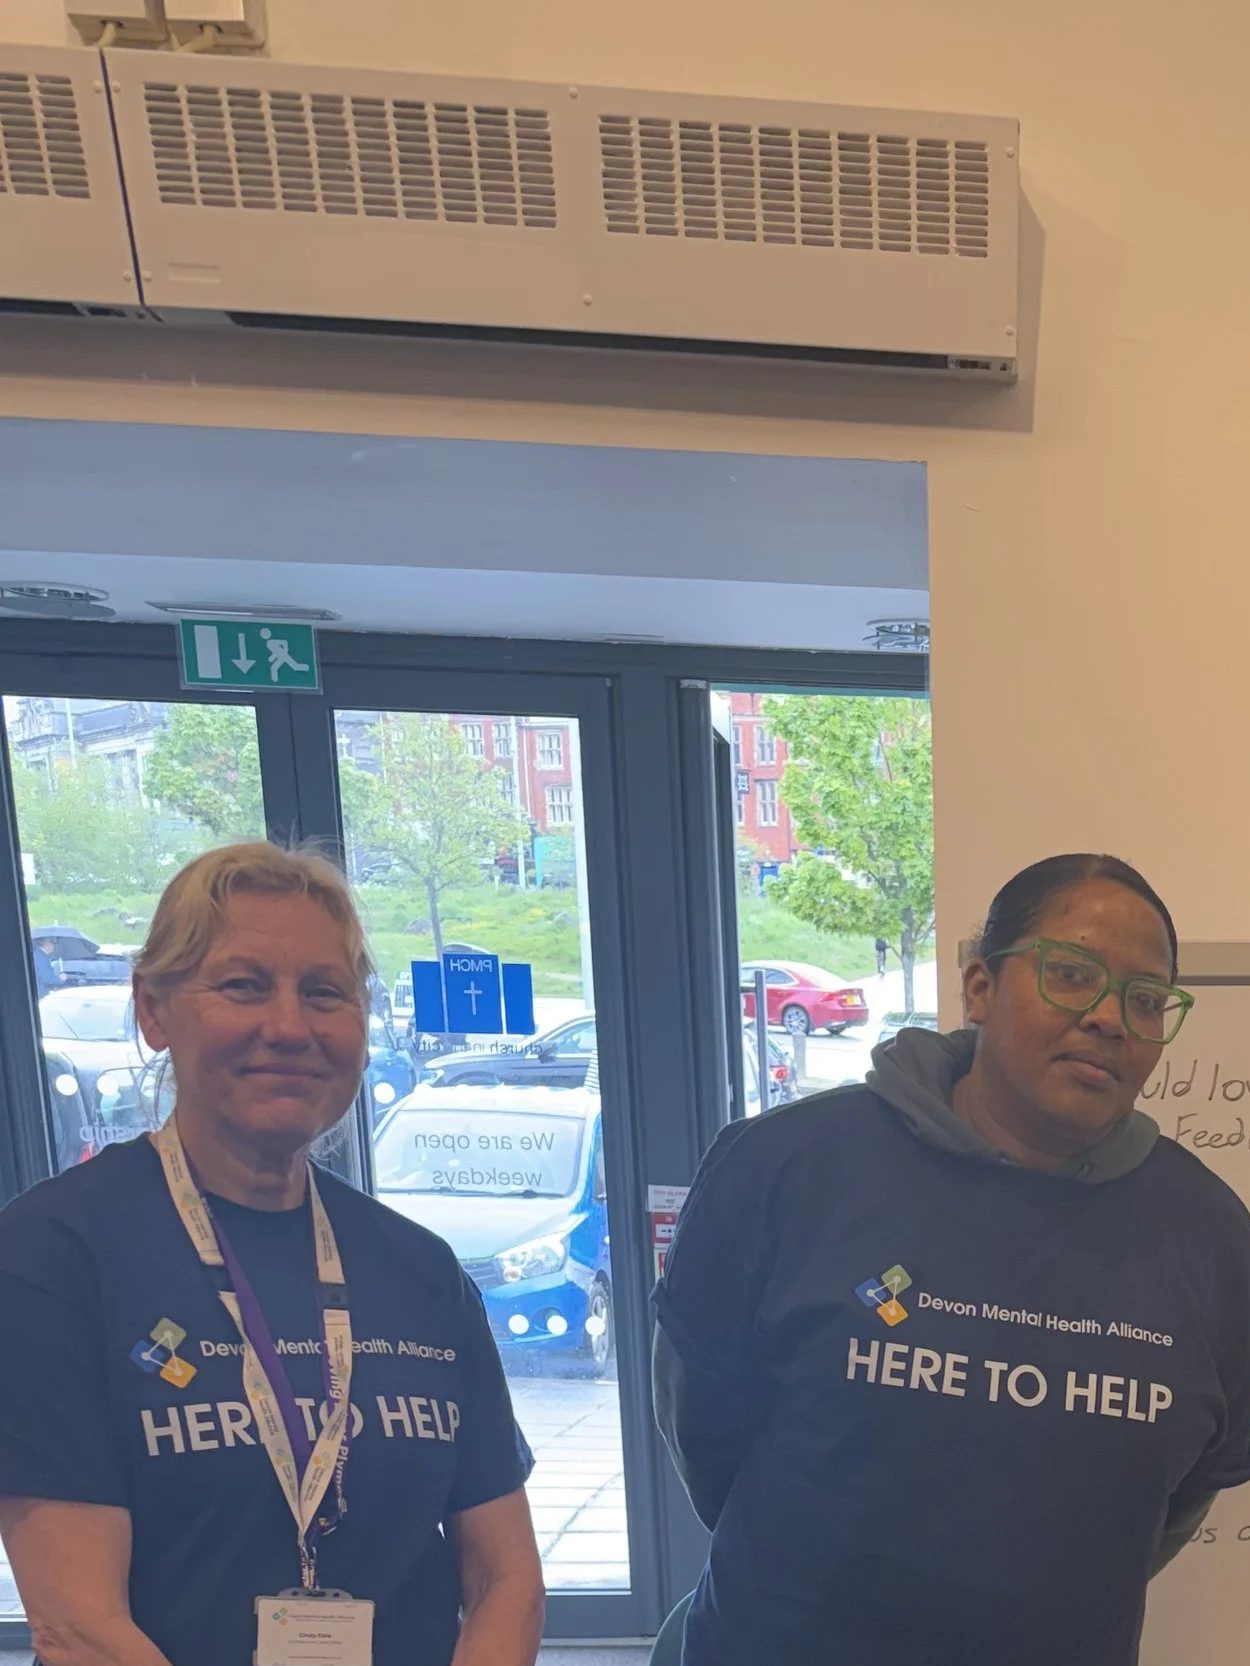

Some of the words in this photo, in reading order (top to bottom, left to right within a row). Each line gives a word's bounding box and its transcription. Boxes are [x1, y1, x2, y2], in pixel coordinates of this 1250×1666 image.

[1139, 1059, 1198, 1101] uld
[917, 1291, 977, 1318] Devon
[981, 1302, 1042, 1328] Mental
[1045, 1314, 1102, 1336] Health
[1105, 1320, 1174, 1347] Alliance
[199, 1339, 247, 1358] Devo
[351, 1337, 393, 1356] ealth
[397, 1340, 457, 1362] Alliance
[846, 1336, 969, 1397] HERE
[983, 1359, 1048, 1408] TO
[1064, 1370, 1174, 1424] HELP
[140, 1401, 258, 1457] HER
[375, 1394, 461, 1443] HELP
